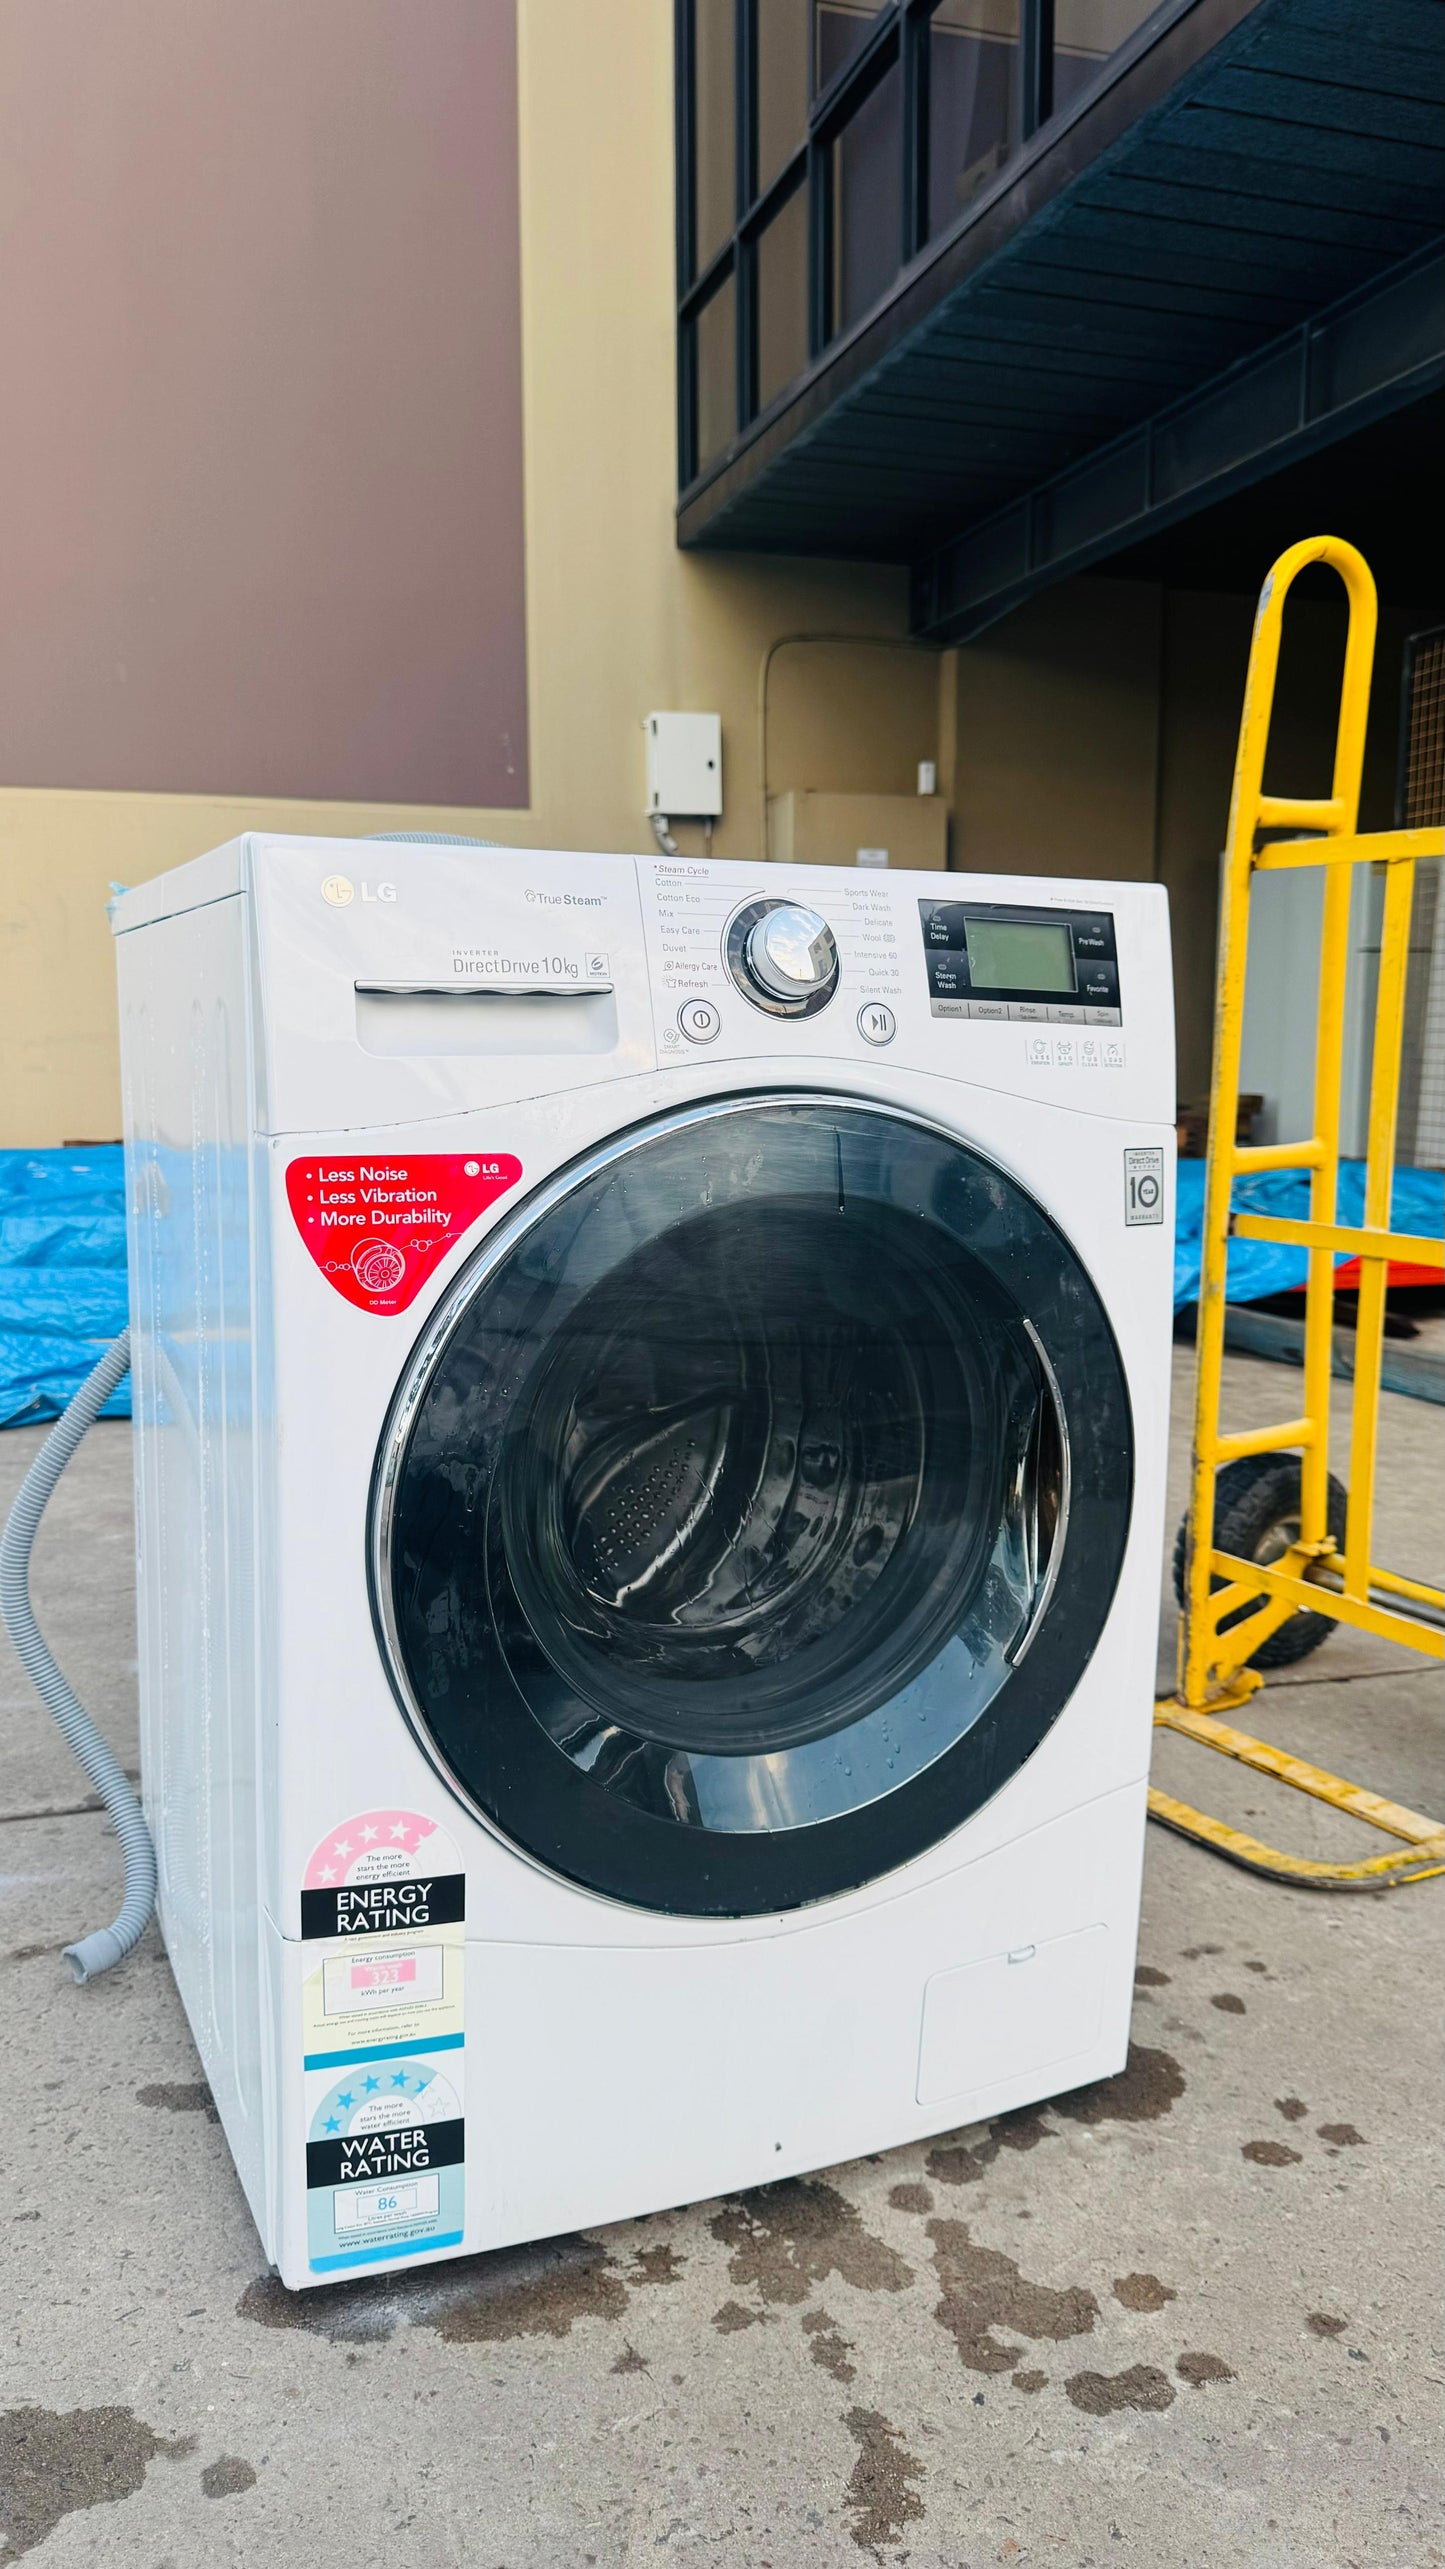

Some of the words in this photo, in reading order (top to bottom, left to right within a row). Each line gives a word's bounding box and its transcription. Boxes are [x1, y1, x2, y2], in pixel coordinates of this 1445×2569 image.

[659, 865, 684, 874] Steam
[687, 866, 709, 875] Cycle
[656, 878, 682, 886] Cotton
[361, 882, 397, 903] LG
[844, 888, 868, 897] Sports
[870, 890, 888, 898] Wear
[657, 893, 684, 902] Cotton
[686, 894, 700, 903] Eco
[853, 902, 869, 910] Dark
[871, 904, 891, 912] Wash
[658, 910, 674, 918] Mix
[864, 918, 893, 926] Delicate
[930, 923, 948, 931] Time
[660, 926, 680, 934] Easy
[682, 926, 700, 934] Care
[862, 934, 881, 942] Wool
[930, 932, 950, 942] Delay
[662, 944, 686, 952] Duvet
[854, 951, 886, 959] Intensive
[675, 962, 700, 971] Allergy
[702, 962, 718, 971] Care
[868, 968, 889, 976] Quick
[935, 972, 957, 980] Steam
[678, 980, 708, 988] Refresh
[937, 981, 957, 989] Wash
[1086, 984, 1109, 994] Favorite
[860, 986, 880, 994] Silent
[882, 986, 902, 994] Wash
[938, 1004, 962, 1013] Option1
[978, 1006, 1002, 1015] Option2
[1020, 1006, 1036, 1014] Rinse
[482, 1163, 499, 1174] LG
[318, 1168, 355, 1182] Less
[360, 1167, 408, 1182] Noise
[320, 1190, 356, 1204] Less
[360, 1188, 437, 1204] Vibration
[1130, 1175, 1159, 1208] 10
[320, 1212, 366, 1226] More
[372, 1209, 452, 1227] Durability
[382, 1870, 410, 1878] efficient
[336, 1883, 432, 1912] ENERGY
[336, 1906, 430, 1932] RATING
[352, 1956, 373, 1964] Energy
[375, 1951, 416, 1960] consumption
[372, 1969, 399, 1986] 323
[392, 2110, 410, 2118] more
[382, 2118, 410, 2126] efficient
[341, 2130, 428, 2158] WATER
[340, 2149, 430, 2180] RATING
[355, 2188, 375, 2196] Water
[377, 2182, 418, 2193] Consumption
[378, 2196, 397, 2210] 86
[340, 2226, 435, 2248] www.waterrating.gov.au
